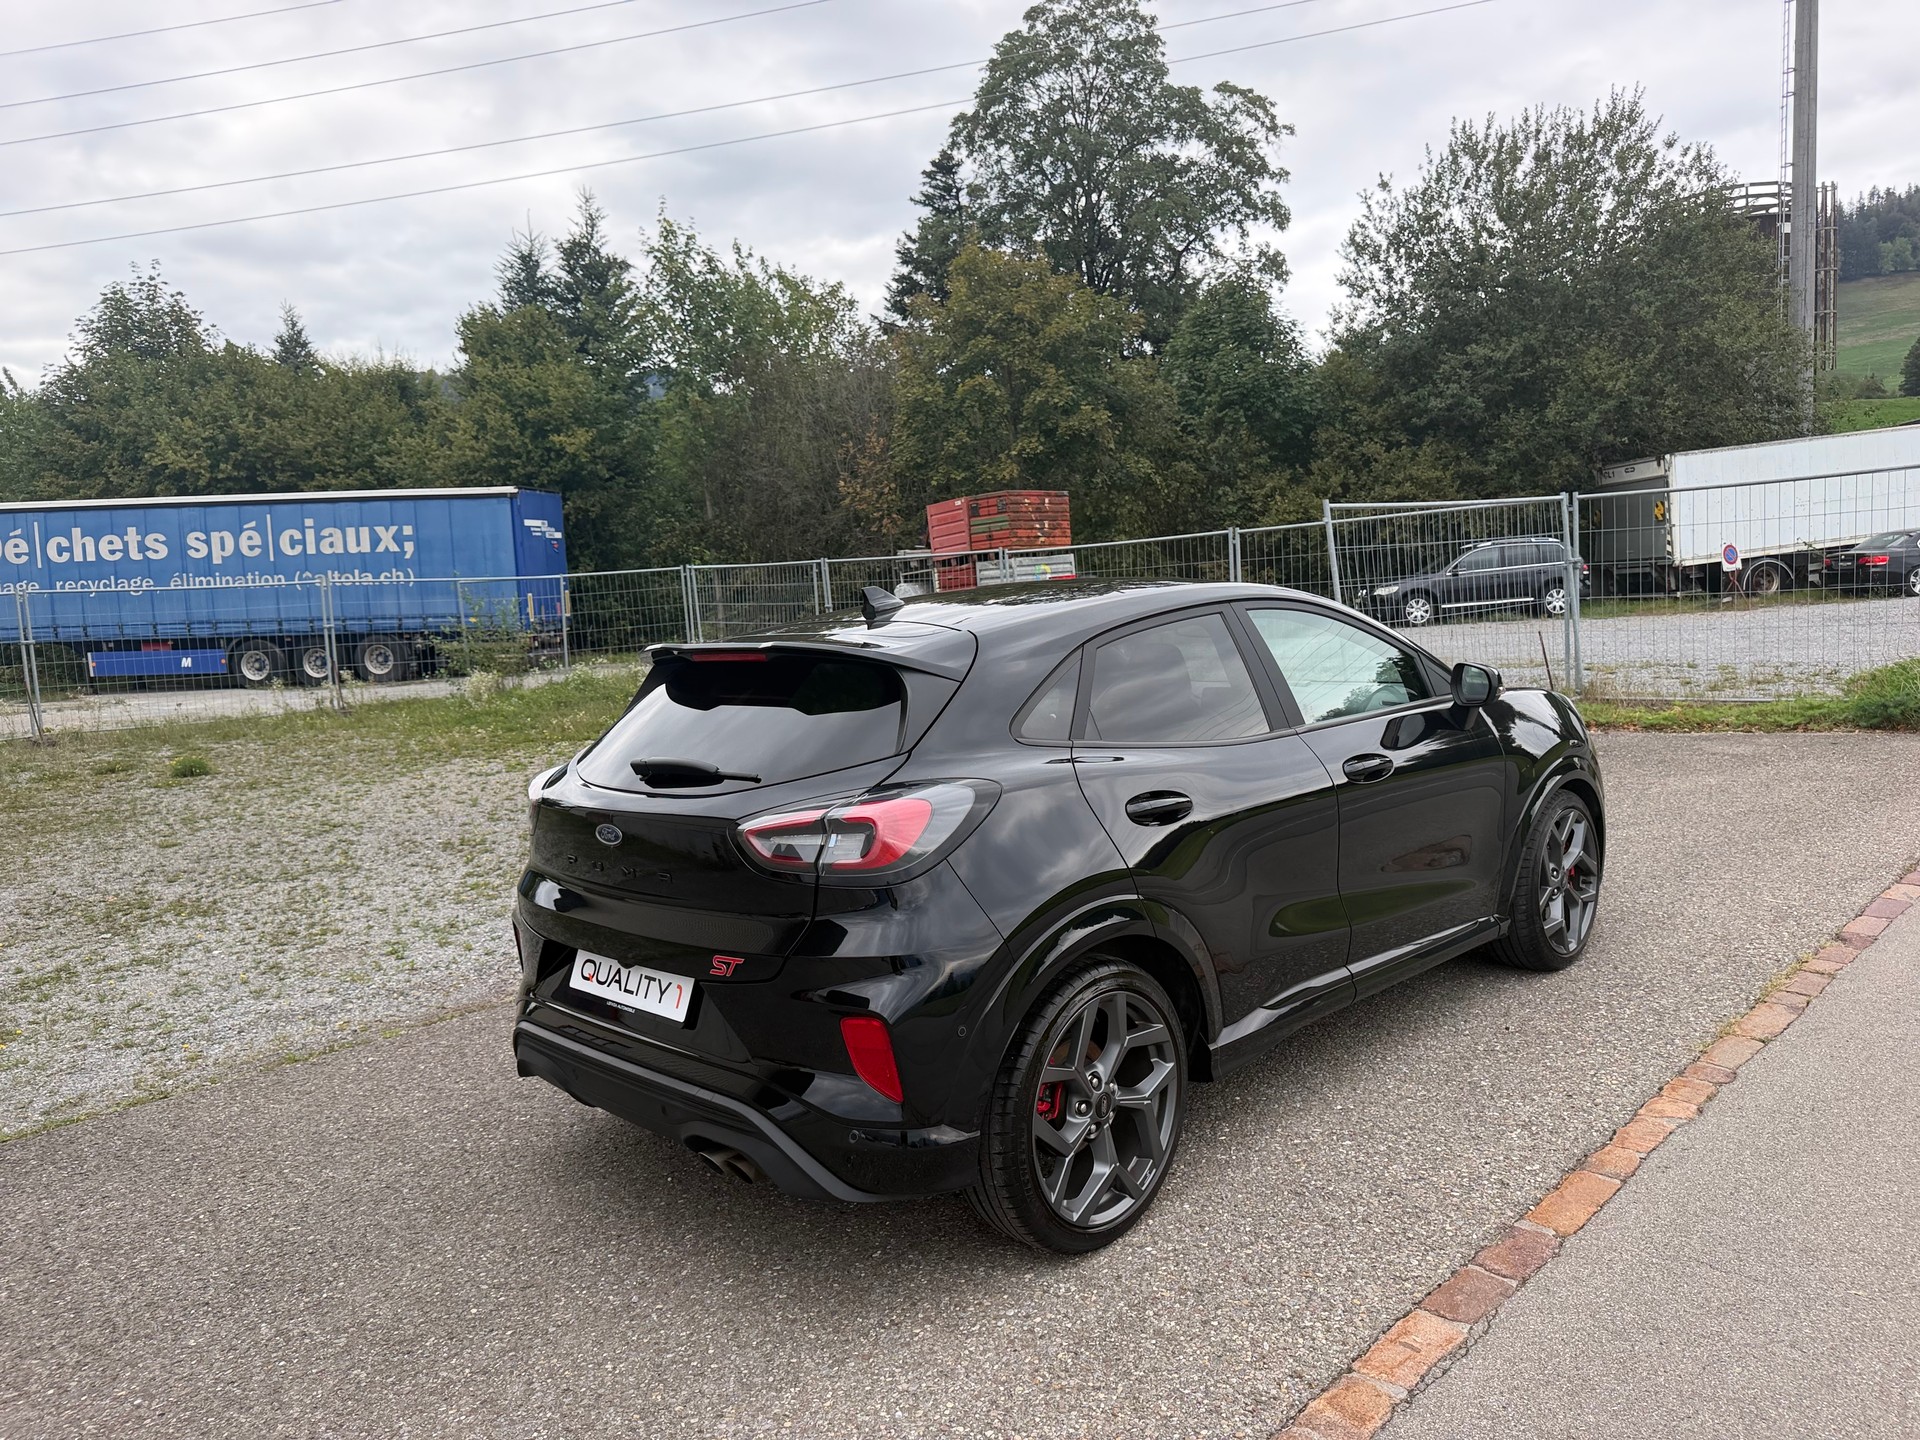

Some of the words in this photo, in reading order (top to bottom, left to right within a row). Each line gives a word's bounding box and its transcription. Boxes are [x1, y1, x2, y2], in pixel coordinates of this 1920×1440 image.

[170, 571, 286, 588] élimination
[710, 955, 745, 977] ST
[581, 959, 672, 1004] QUALITY
[676, 984, 683, 1009] 1
